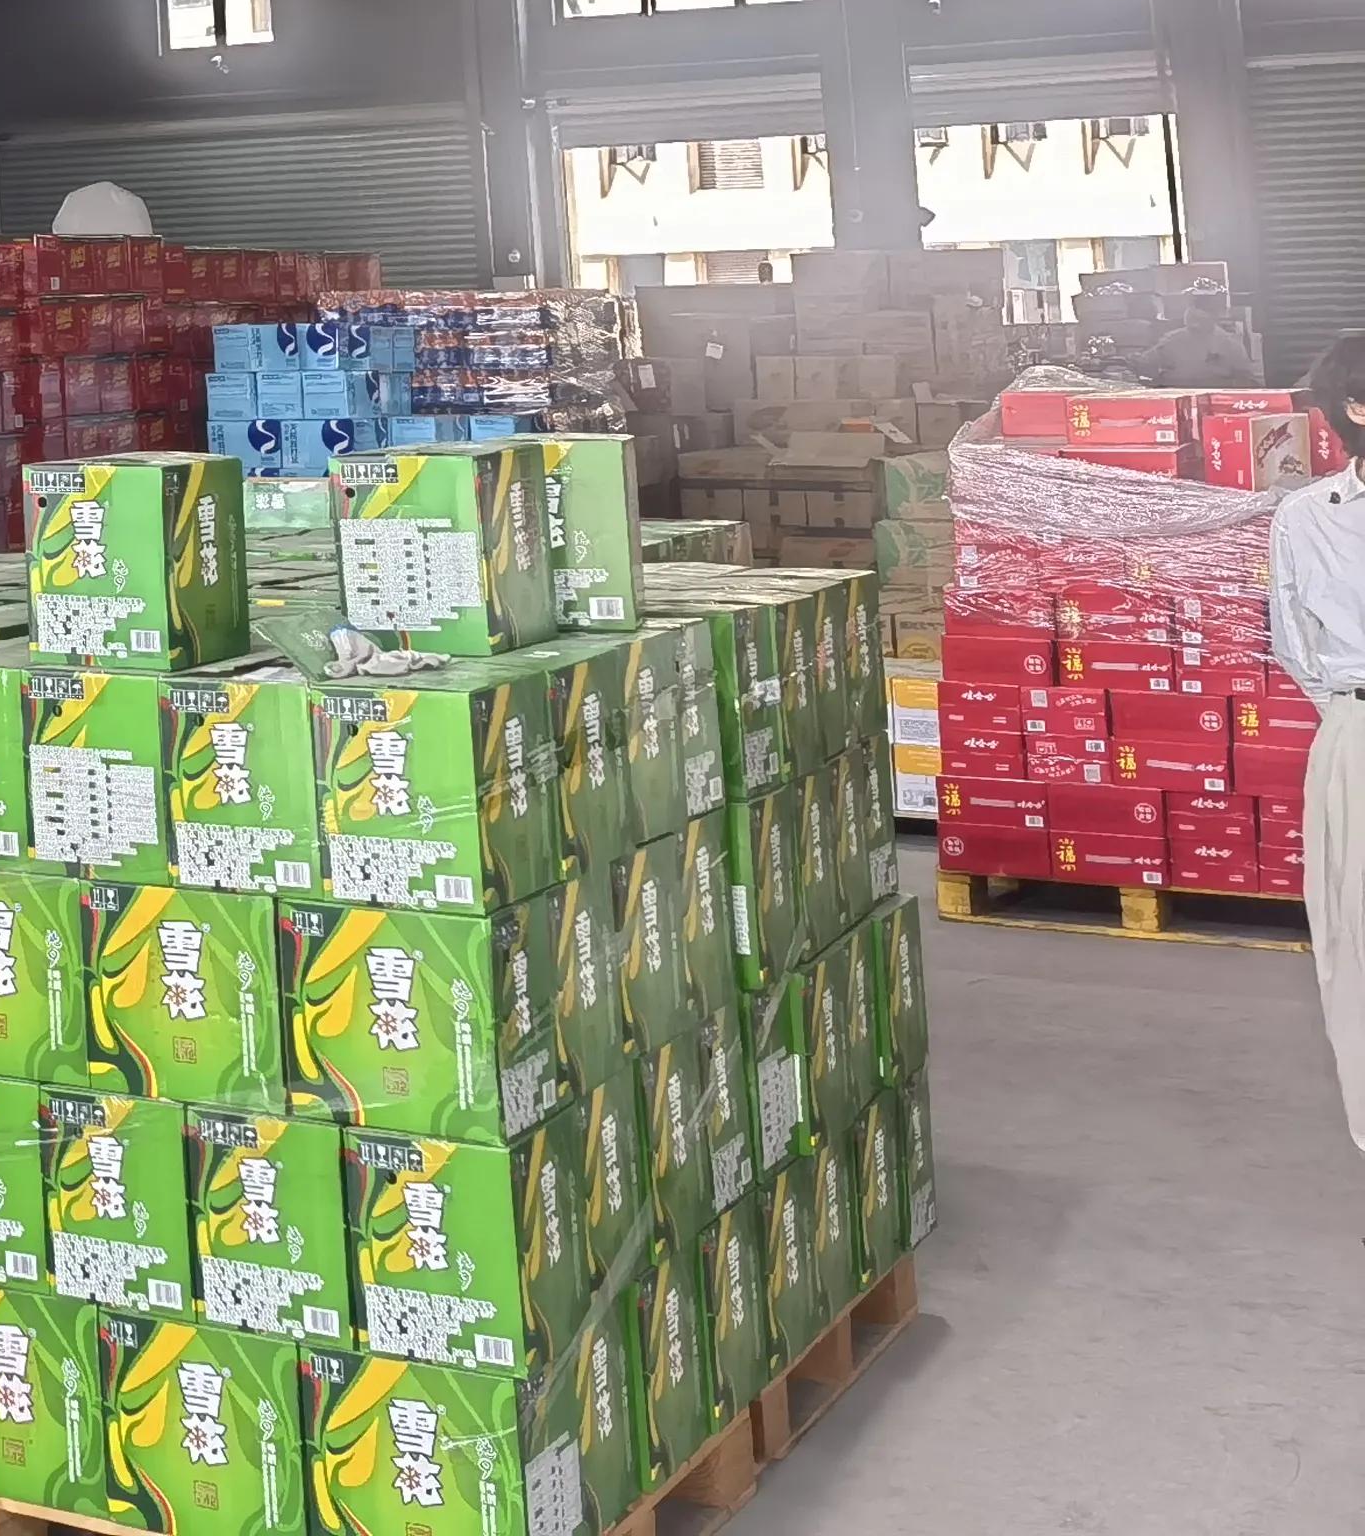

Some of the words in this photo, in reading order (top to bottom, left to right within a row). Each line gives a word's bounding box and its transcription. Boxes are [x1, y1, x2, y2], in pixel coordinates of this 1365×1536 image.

[67, 498, 107, 580] 雪花
[207, 720, 249, 805] 雪花
[365, 729, 411, 818] 雪花
[155, 918, 205, 1021] 雪花
[363, 944, 420, 1052] 雪花
[86, 1134, 126, 1220] 雪花
[236, 1155, 280, 1245] 雪花
[401, 1179, 448, 1272] 雪花
[174, 1358, 229, 1467] 雪花
[386, 1395, 443, 1508] 雪花
